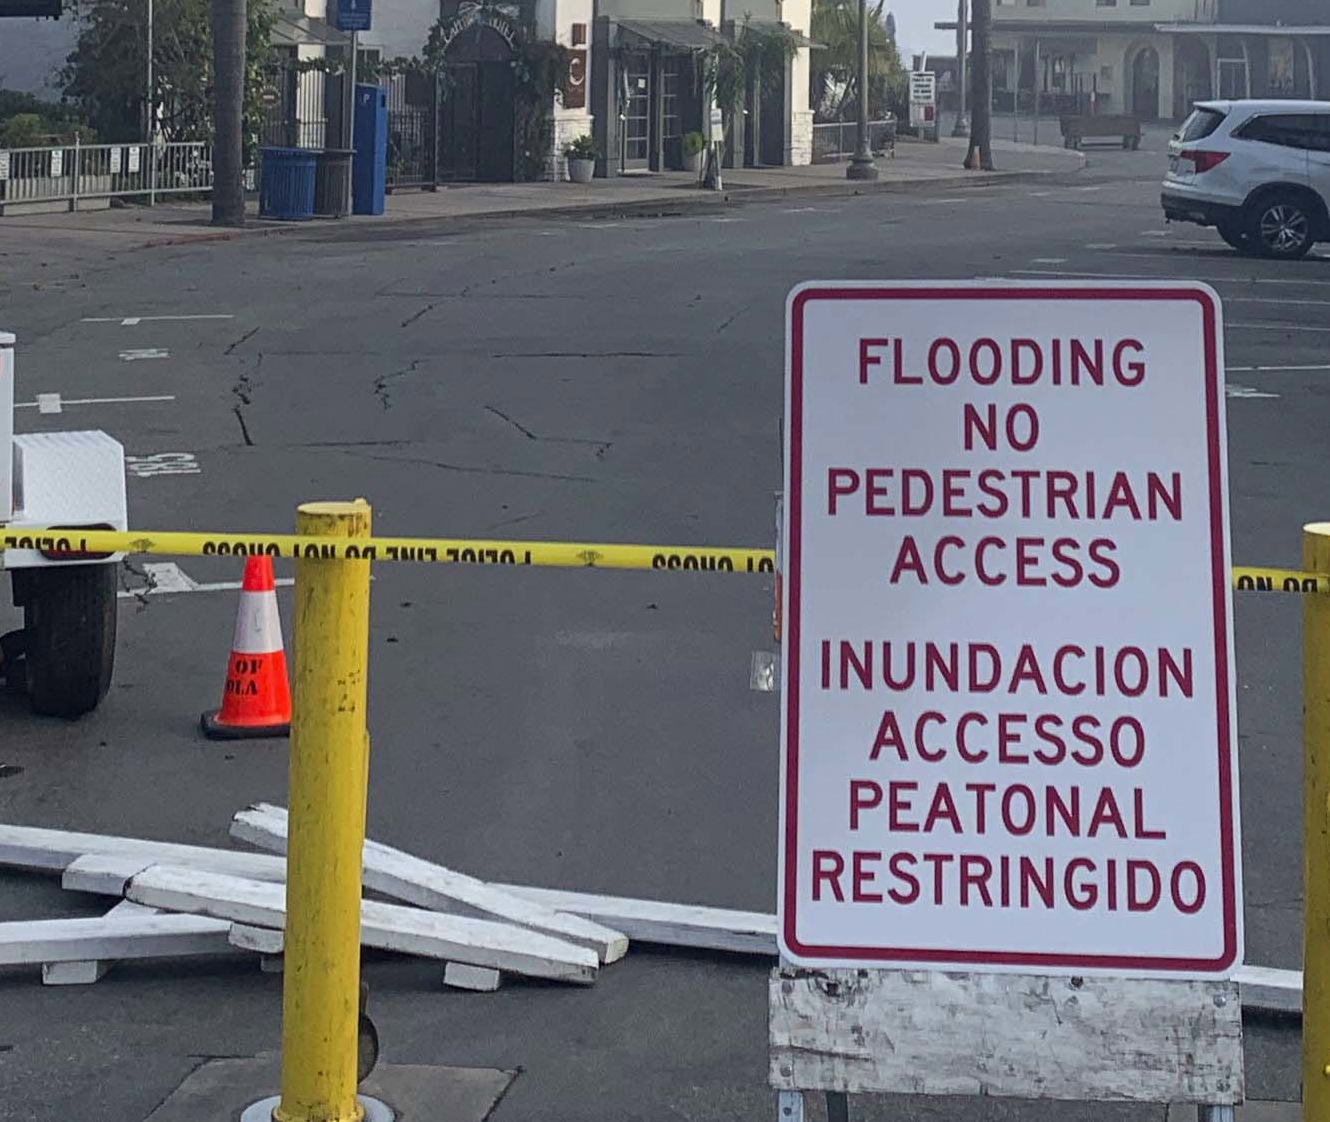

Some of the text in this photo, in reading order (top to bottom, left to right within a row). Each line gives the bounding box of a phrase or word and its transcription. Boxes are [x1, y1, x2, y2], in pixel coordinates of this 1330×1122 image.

[859, 338, 1146, 386] FLOODING
[963, 403, 1039, 452] NO
[828, 468, 1182, 521] PEDESTRIAN
[890, 536, 1121, 589] ACCESS
[820, 641, 1194, 698] INUNDACION
[870, 712, 1146, 768] ACCESSO
[849, 780, 1166, 841] PEATONAL
[811, 850, 1207, 915] RESTRINGIDO
